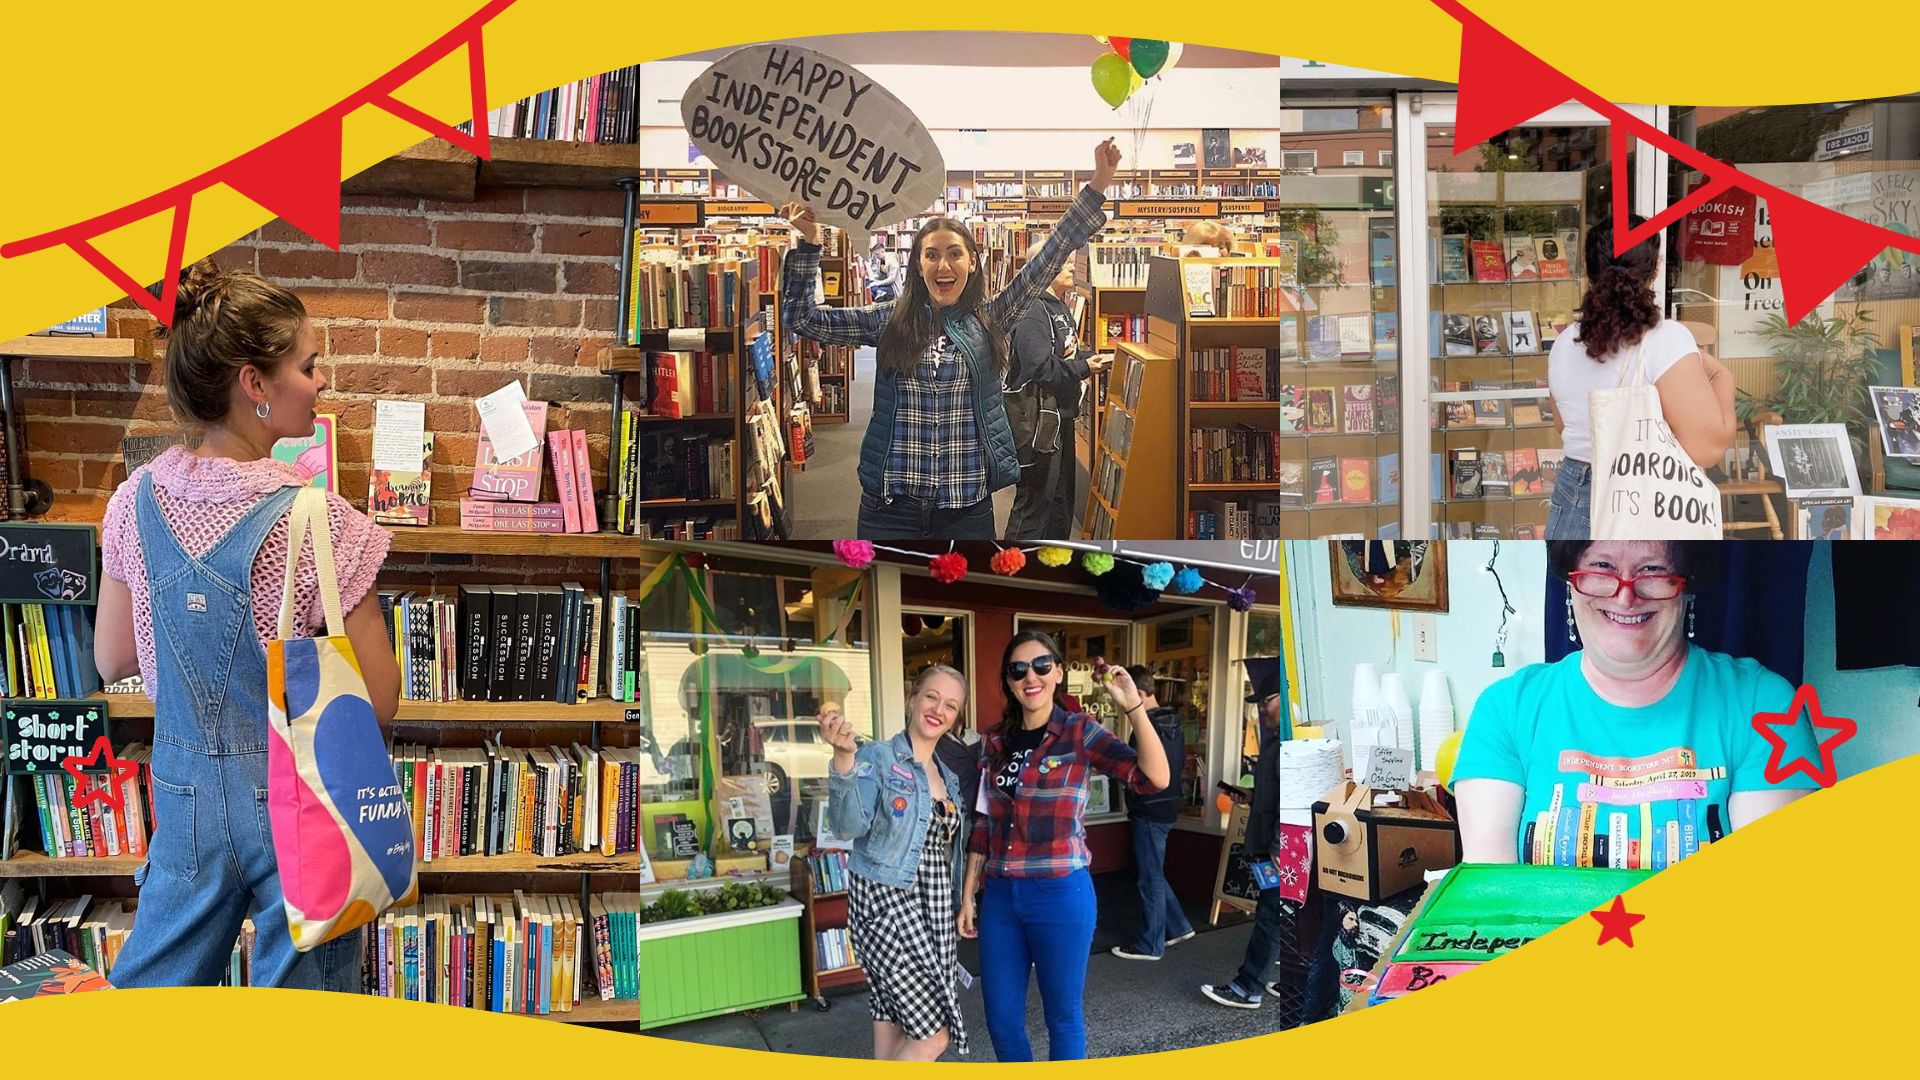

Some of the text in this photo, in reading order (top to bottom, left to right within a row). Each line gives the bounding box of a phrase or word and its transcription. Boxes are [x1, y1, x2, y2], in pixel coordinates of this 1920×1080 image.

[763, 47, 872, 117] HAPPY
[705, 71, 921, 194] INDEPENDENT
[1873, 174, 1914, 194] IT FELL
[1873, 197, 1911, 224] SKY
[1744, 271, 1771, 290] On
[1345, 403, 1372, 411] ULYSSES
[1347, 420, 1372, 431] JOYCE
[1635, 419, 1666, 443] IT'S
[481, 474, 529, 496] STOP
[373, 486, 428, 512] home
[494, 506, 550, 515] ONE LAST STOP
[1612, 490, 1640, 516] IT'S
[494, 520, 550, 529] ONE LAST STOP
[0, 535, 57, 564] Drama
[472, 613, 480, 680] SUCCESSION
[498, 613, 508, 680] SUCCESSION
[519, 613, 529, 680] SUCCESSION
[541, 613, 552, 680] SUCCESSION
[1080, 694, 1112, 718] hop
[18, 714, 89, 741] Short
[8, 740, 84, 771] story
[1562, 756, 1615, 771] INDEPENDENT
[1662, 756, 1674, 766] DAY
[1647, 773, 1666, 783] April
[1680, 770, 1697, 778] 2019
[357, 787, 375, 800] IT'S
[72, 818, 82, 844] Space
[82, 814, 91, 839] BLACK
